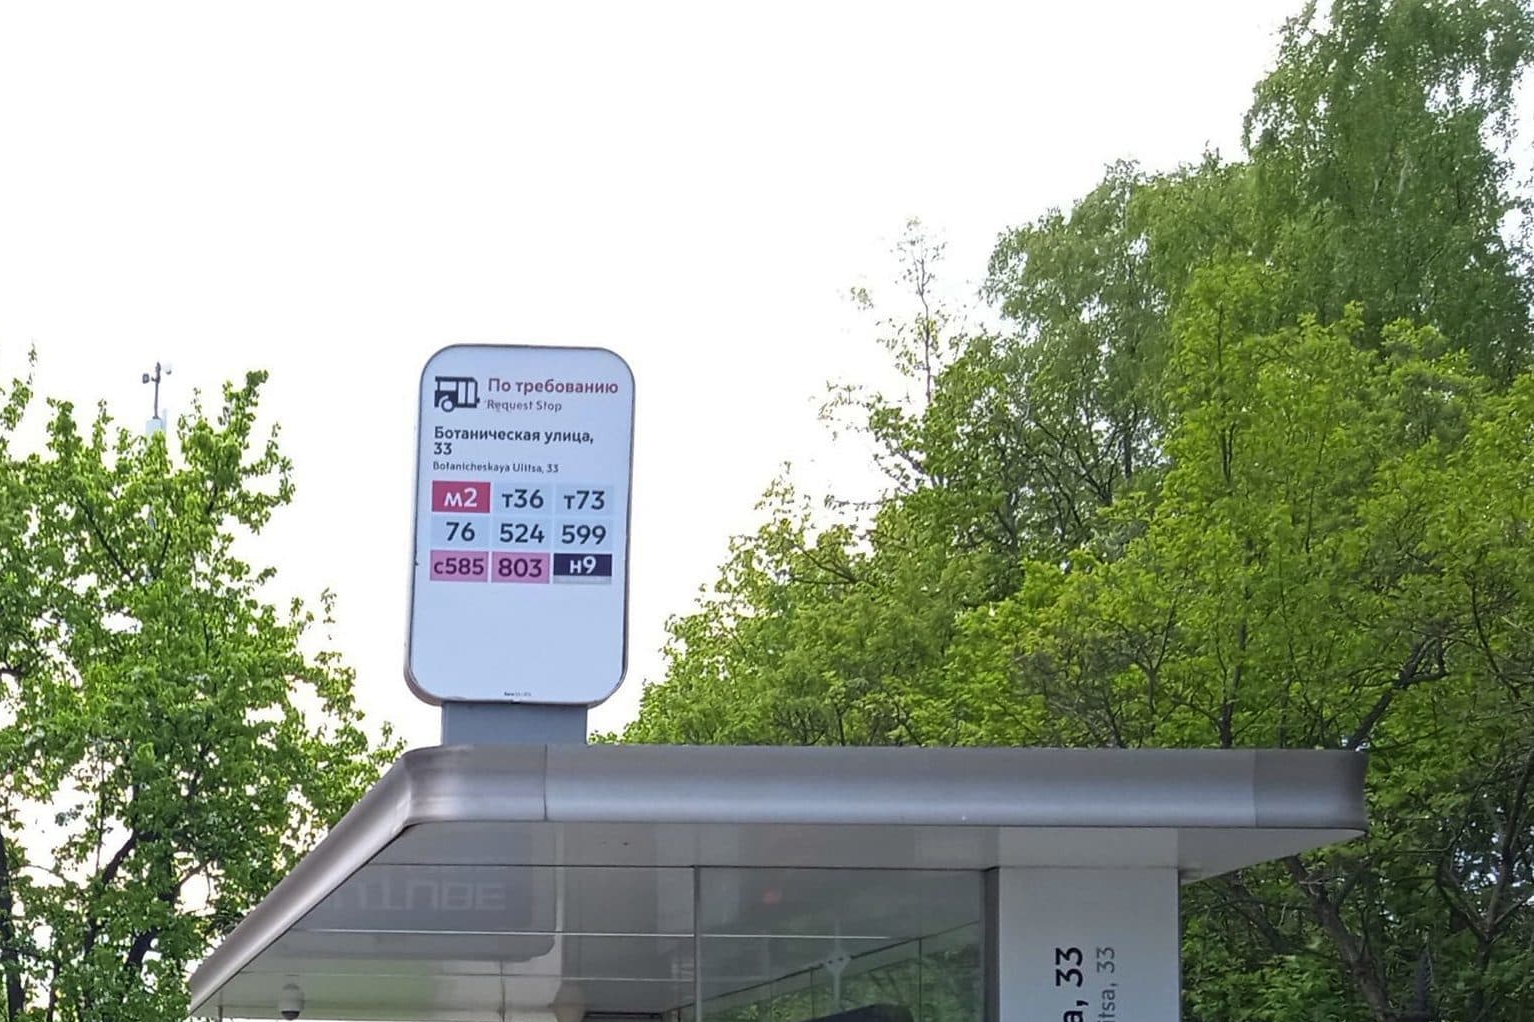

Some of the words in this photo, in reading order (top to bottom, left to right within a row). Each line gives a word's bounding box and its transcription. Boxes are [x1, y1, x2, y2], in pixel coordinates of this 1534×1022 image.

[488, 378, 511, 393] По
[516, 379, 618, 396] требованию
[487, 400, 533, 412] Request
[536, 400, 562, 412] Stop
[434, 426, 540, 441] Ботаническая
[544, 430, 594, 444] улица,
[433, 442, 453, 456] 33
[433, 461, 510, 473] Botanicheskaya
[513, 463, 544, 474] Ulitsa,
[546, 464, 559, 474] 33
[444, 488, 478, 508] м2
[502, 489, 544, 509] т36
[564, 490, 605, 510] т73
[446, 522, 475, 541] 76
[499, 523, 545, 543] 524
[561, 525, 607, 544] 599
[433, 557, 484, 575] с585
[498, 558, 542, 578] 803
[569, 556, 596, 574] н9
[1055, 947, 1083, 987] 33
[1096, 946, 1115, 973] 33
